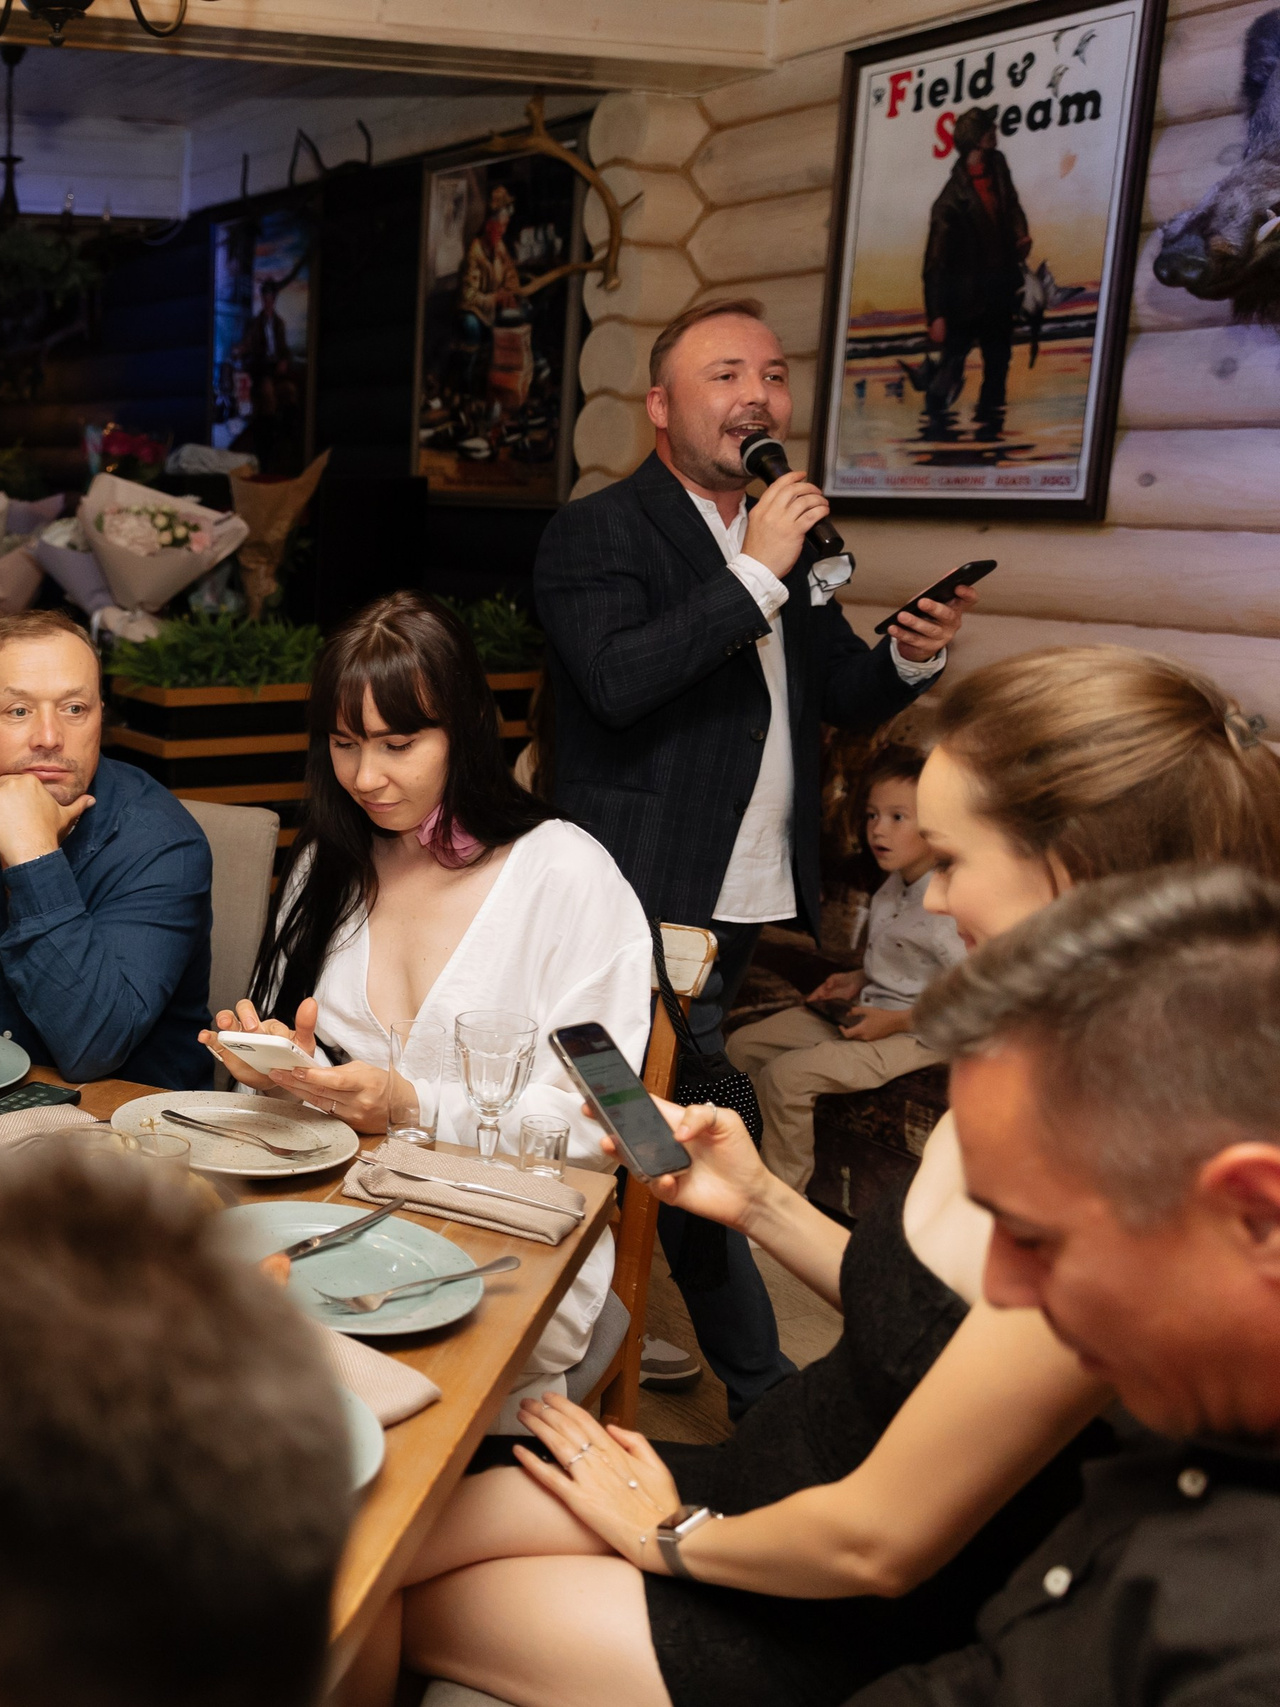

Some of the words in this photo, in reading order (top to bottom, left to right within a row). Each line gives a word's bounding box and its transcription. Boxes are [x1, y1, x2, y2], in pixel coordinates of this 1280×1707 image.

[886, 51, 996, 119] Field
[1006, 51, 1036, 88] &
[932, 89, 1102, 160] Seam
